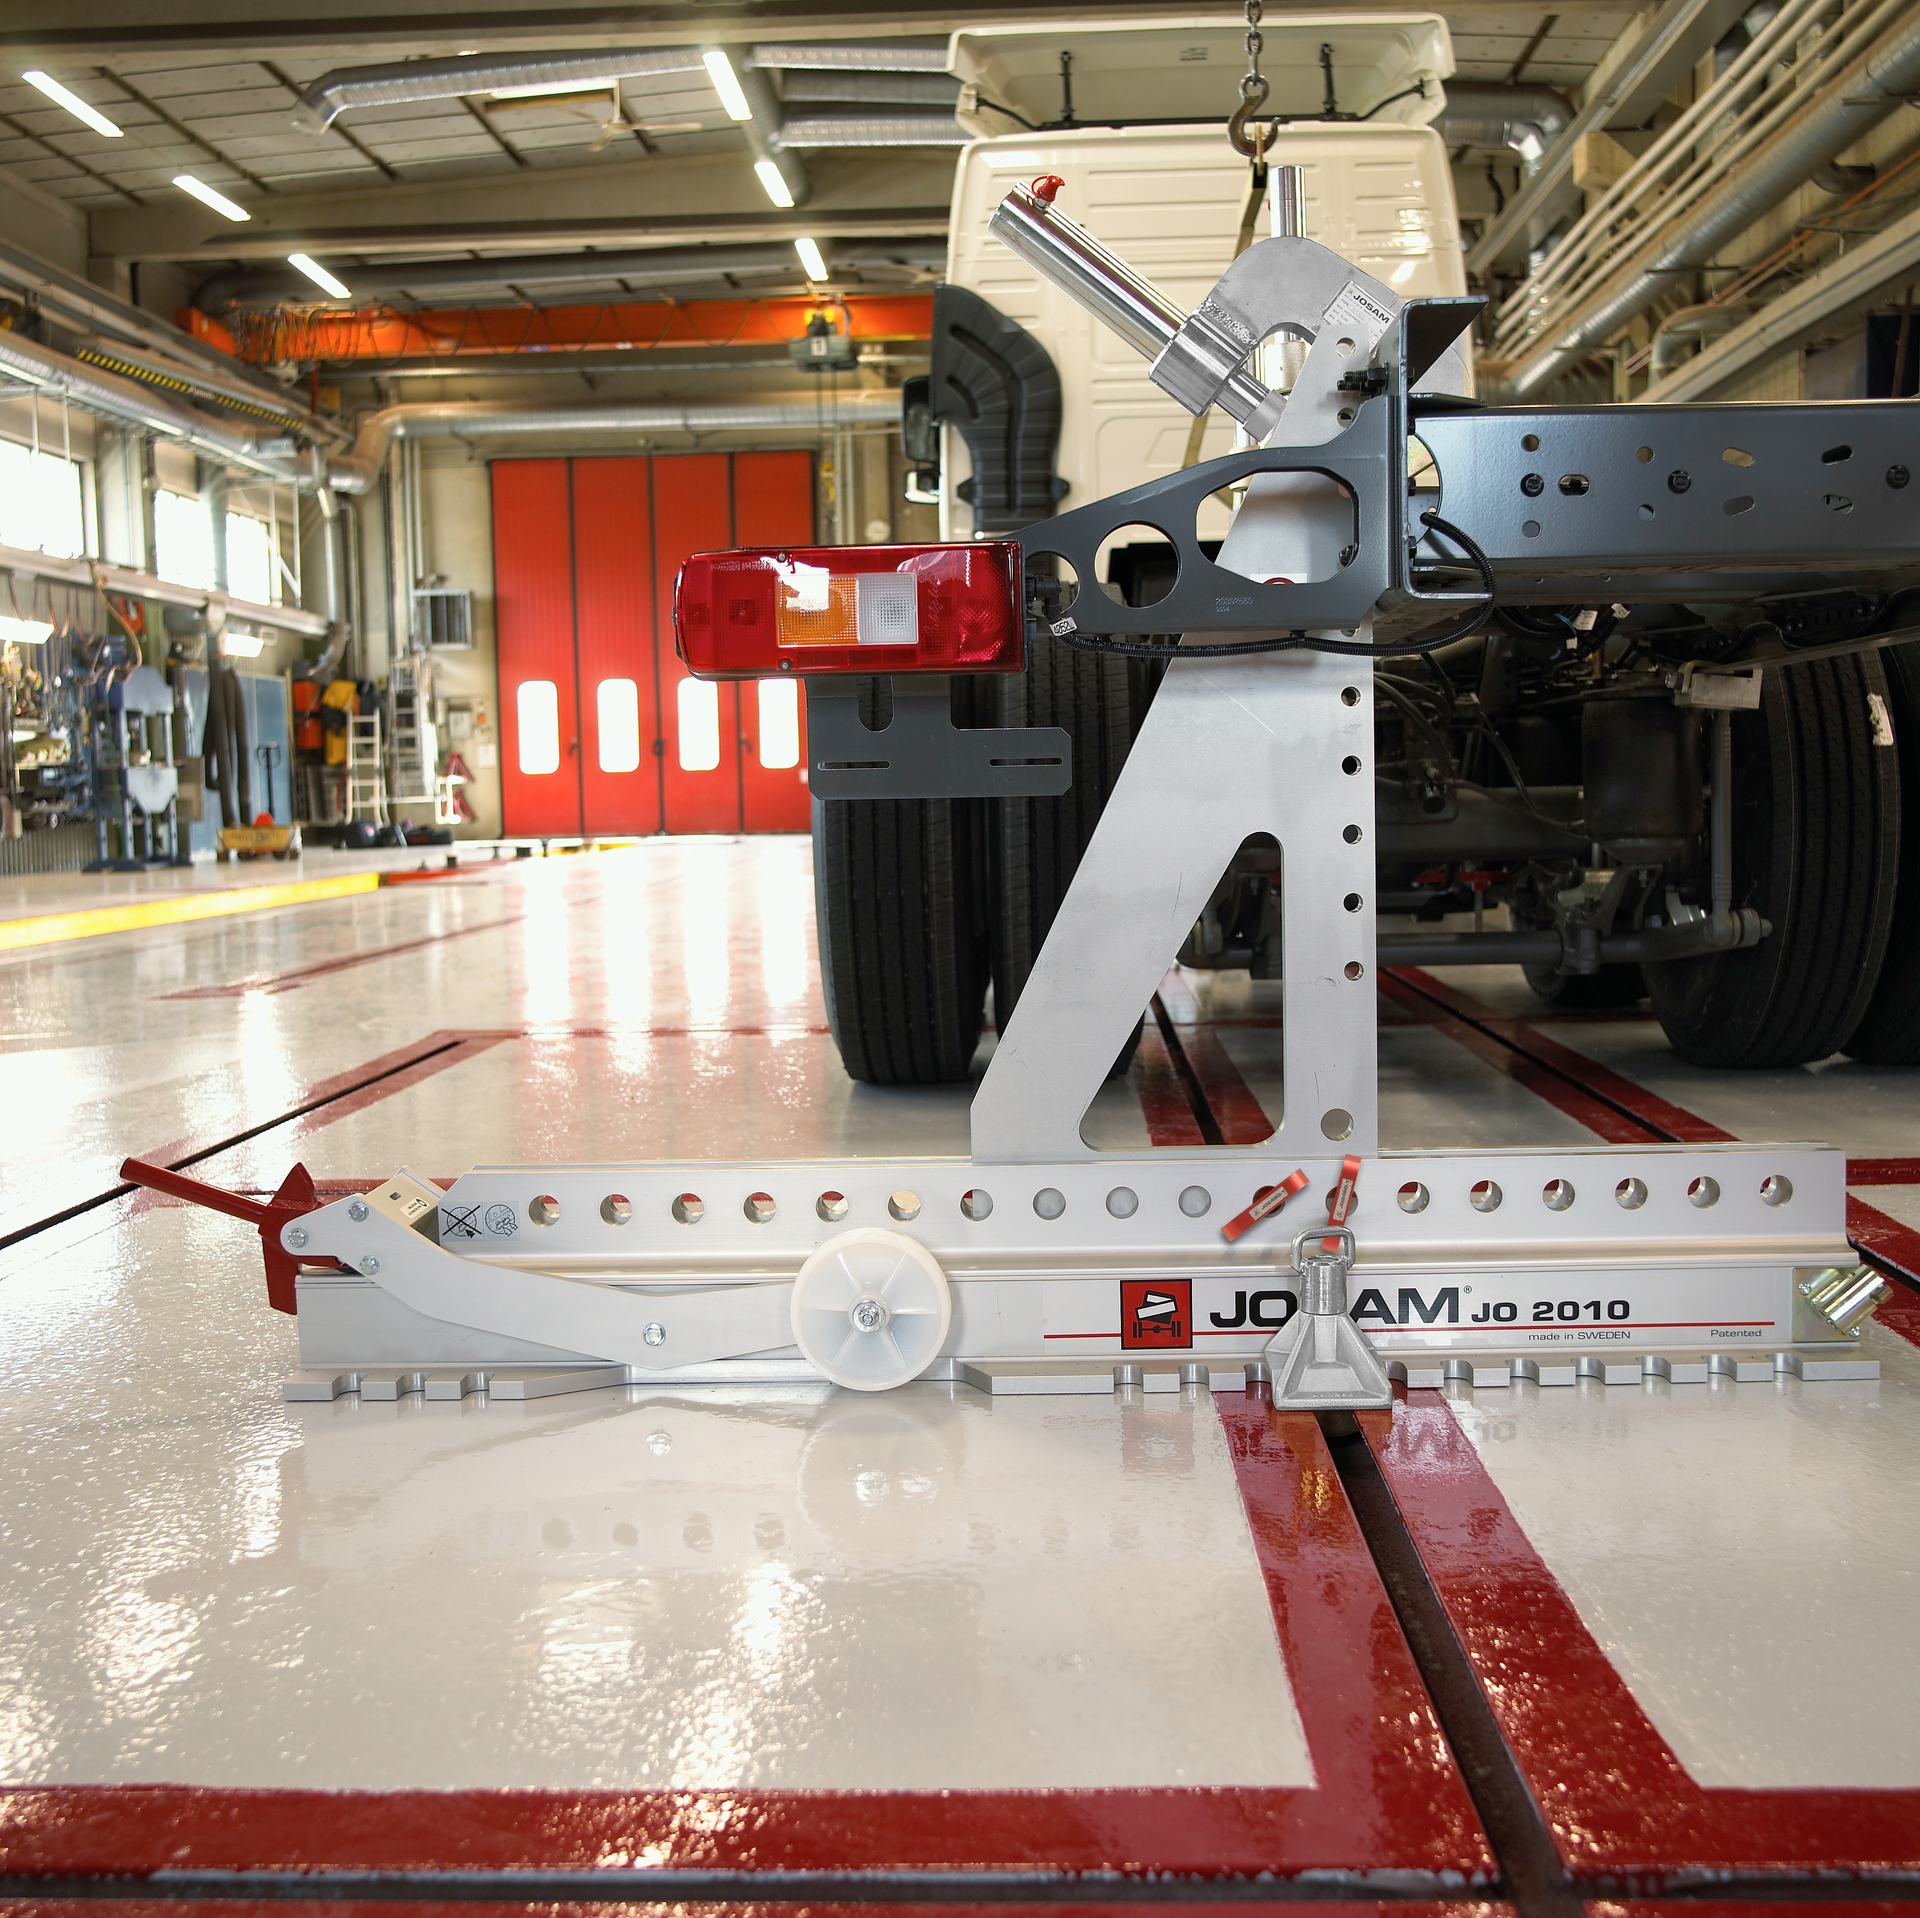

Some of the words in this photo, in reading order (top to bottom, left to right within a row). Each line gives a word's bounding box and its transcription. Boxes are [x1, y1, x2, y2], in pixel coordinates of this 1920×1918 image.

[1353, 294, 1390, 324] JOSAM
[1209, 1286, 1459, 1328] JOAM
[1471, 1302, 1517, 1323] JO
[1532, 1299, 1630, 1322] 2010
[1528, 1332, 1560, 1341] made
[1564, 1332, 1574, 1340] in
[1577, 1331, 1631, 1340] SWEDEN
[1710, 1329, 1762, 1338] Patented
